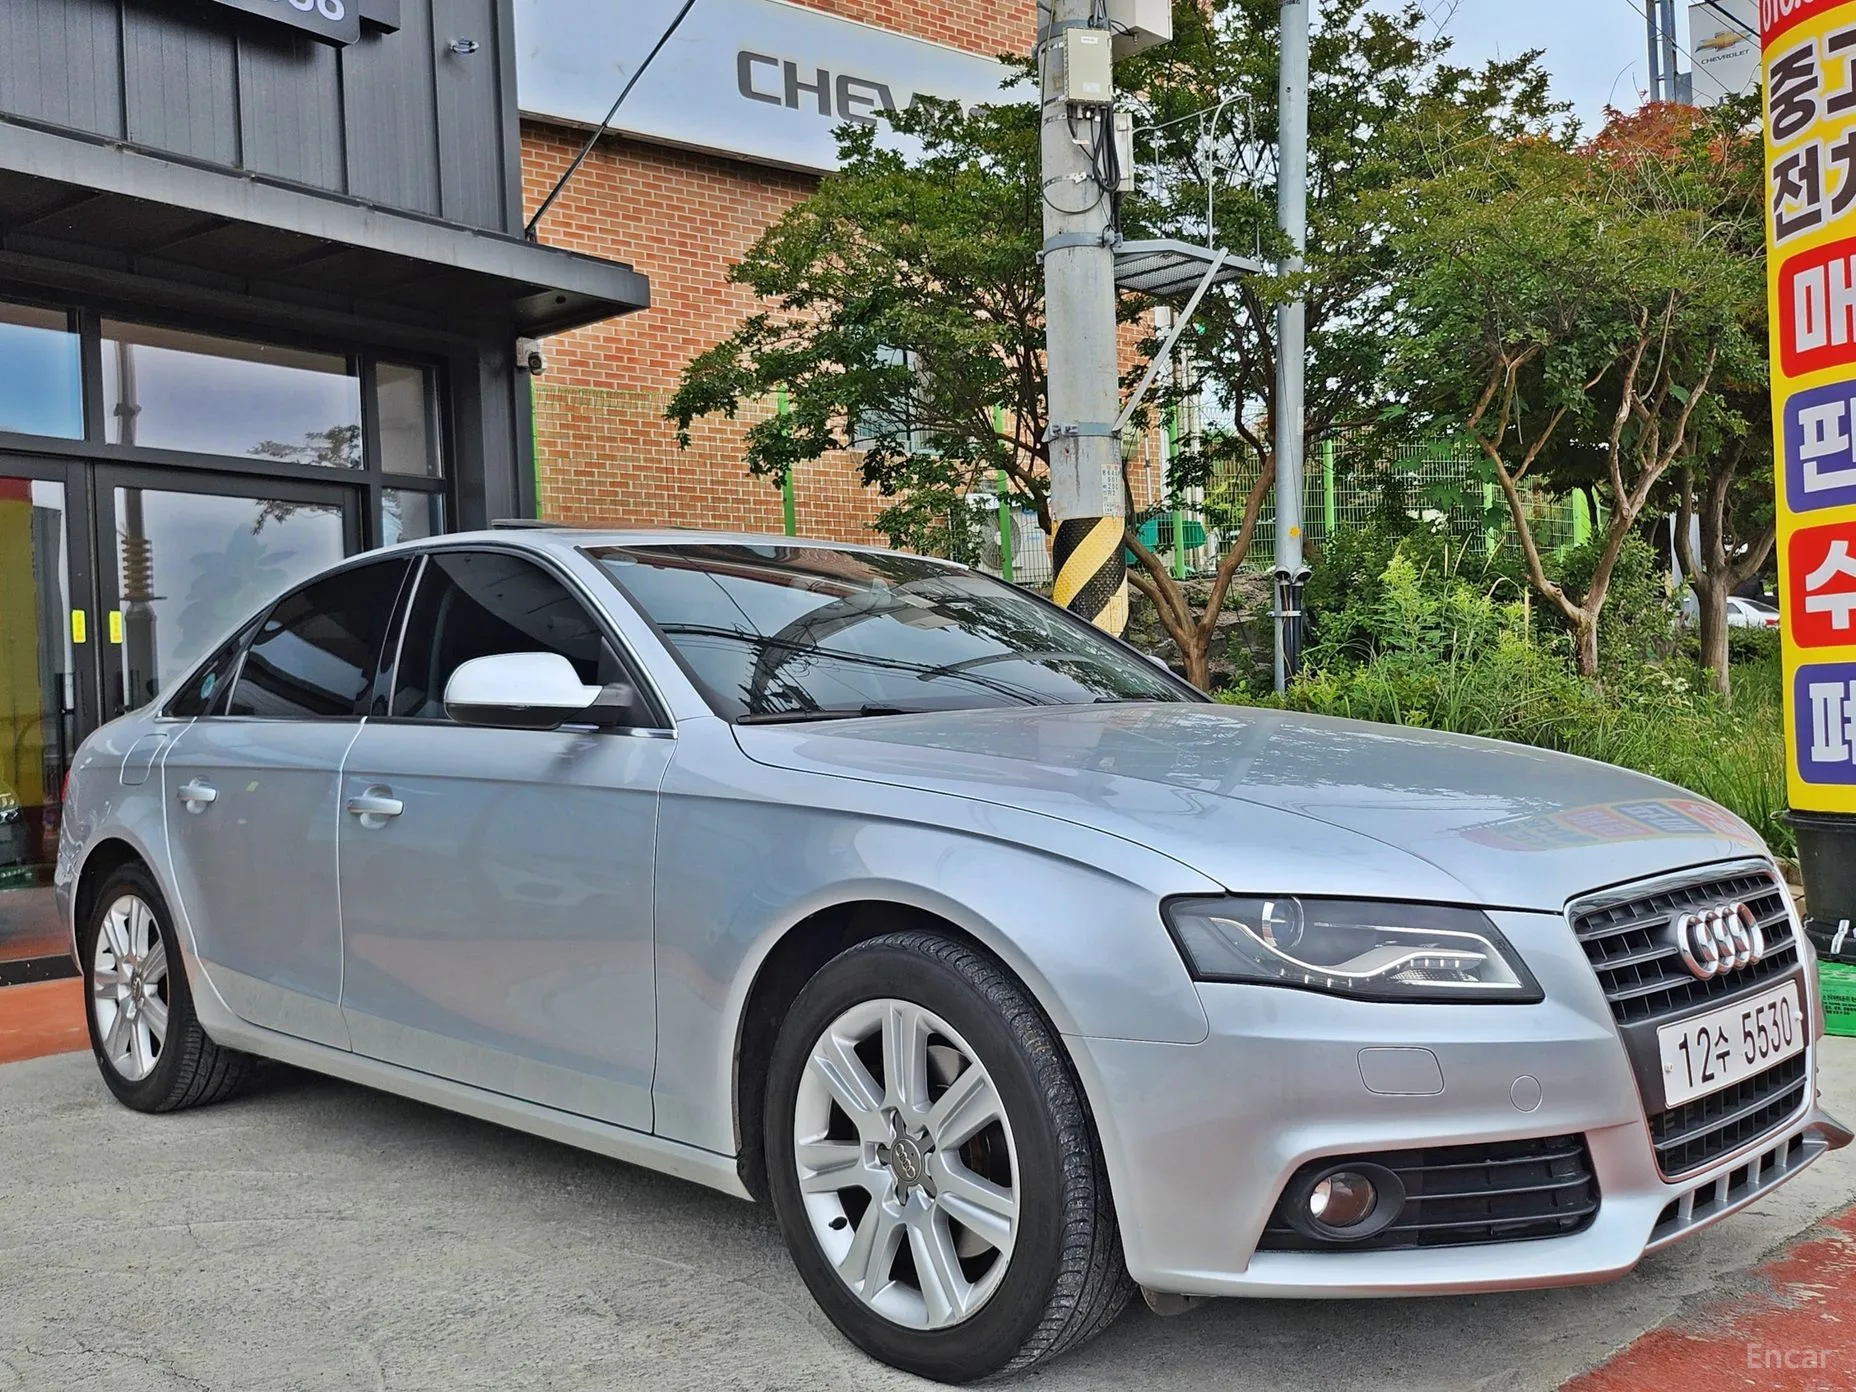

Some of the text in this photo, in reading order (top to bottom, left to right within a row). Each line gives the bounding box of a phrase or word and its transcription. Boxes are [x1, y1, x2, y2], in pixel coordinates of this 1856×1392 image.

[1701, 49, 1750, 65] CHEVROLET
[1678, 996, 1792, 1088] 12수 5530
